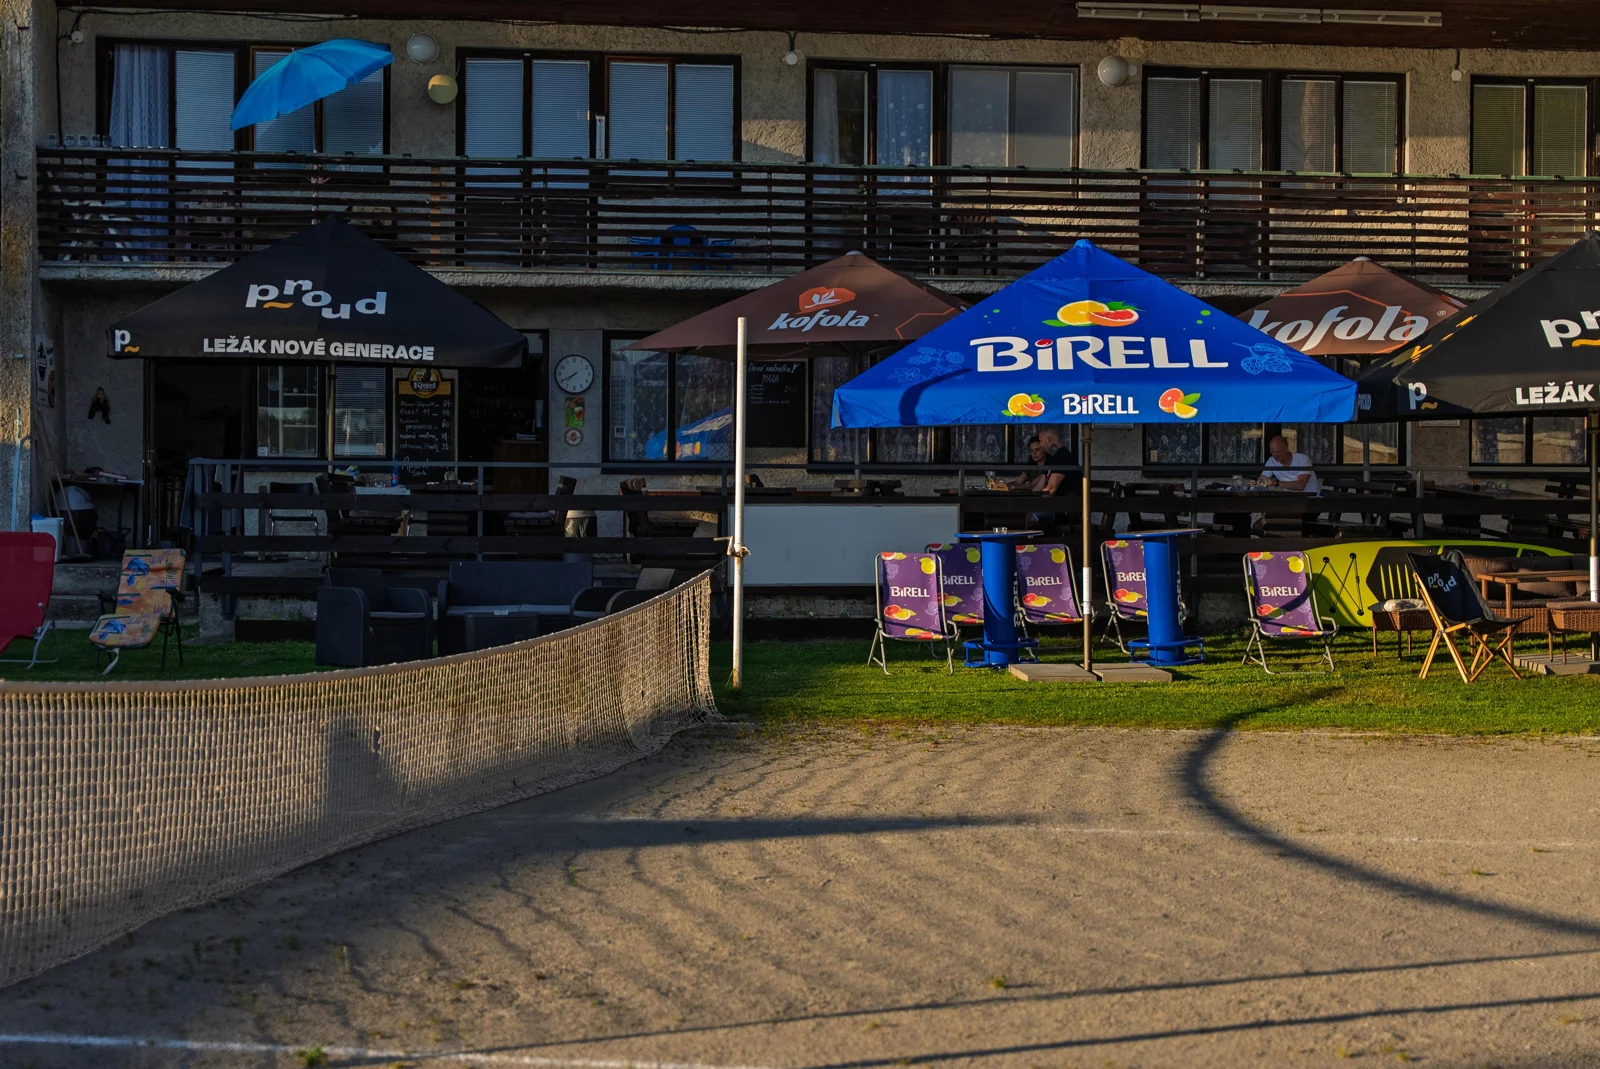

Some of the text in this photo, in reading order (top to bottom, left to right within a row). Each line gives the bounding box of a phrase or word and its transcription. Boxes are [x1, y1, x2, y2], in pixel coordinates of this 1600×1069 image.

[245, 279, 387, 319] proud
[767, 309, 870, 333] kofola
[1247, 305, 1430, 352] kofola
[203, 336, 435, 361] LEŽÁK NOVÉ GENERACE
[413, 381, 436, 390] Kozel
[1515, 380, 1595, 405] LEŽÁK
[1427, 573, 1457, 592] proud
